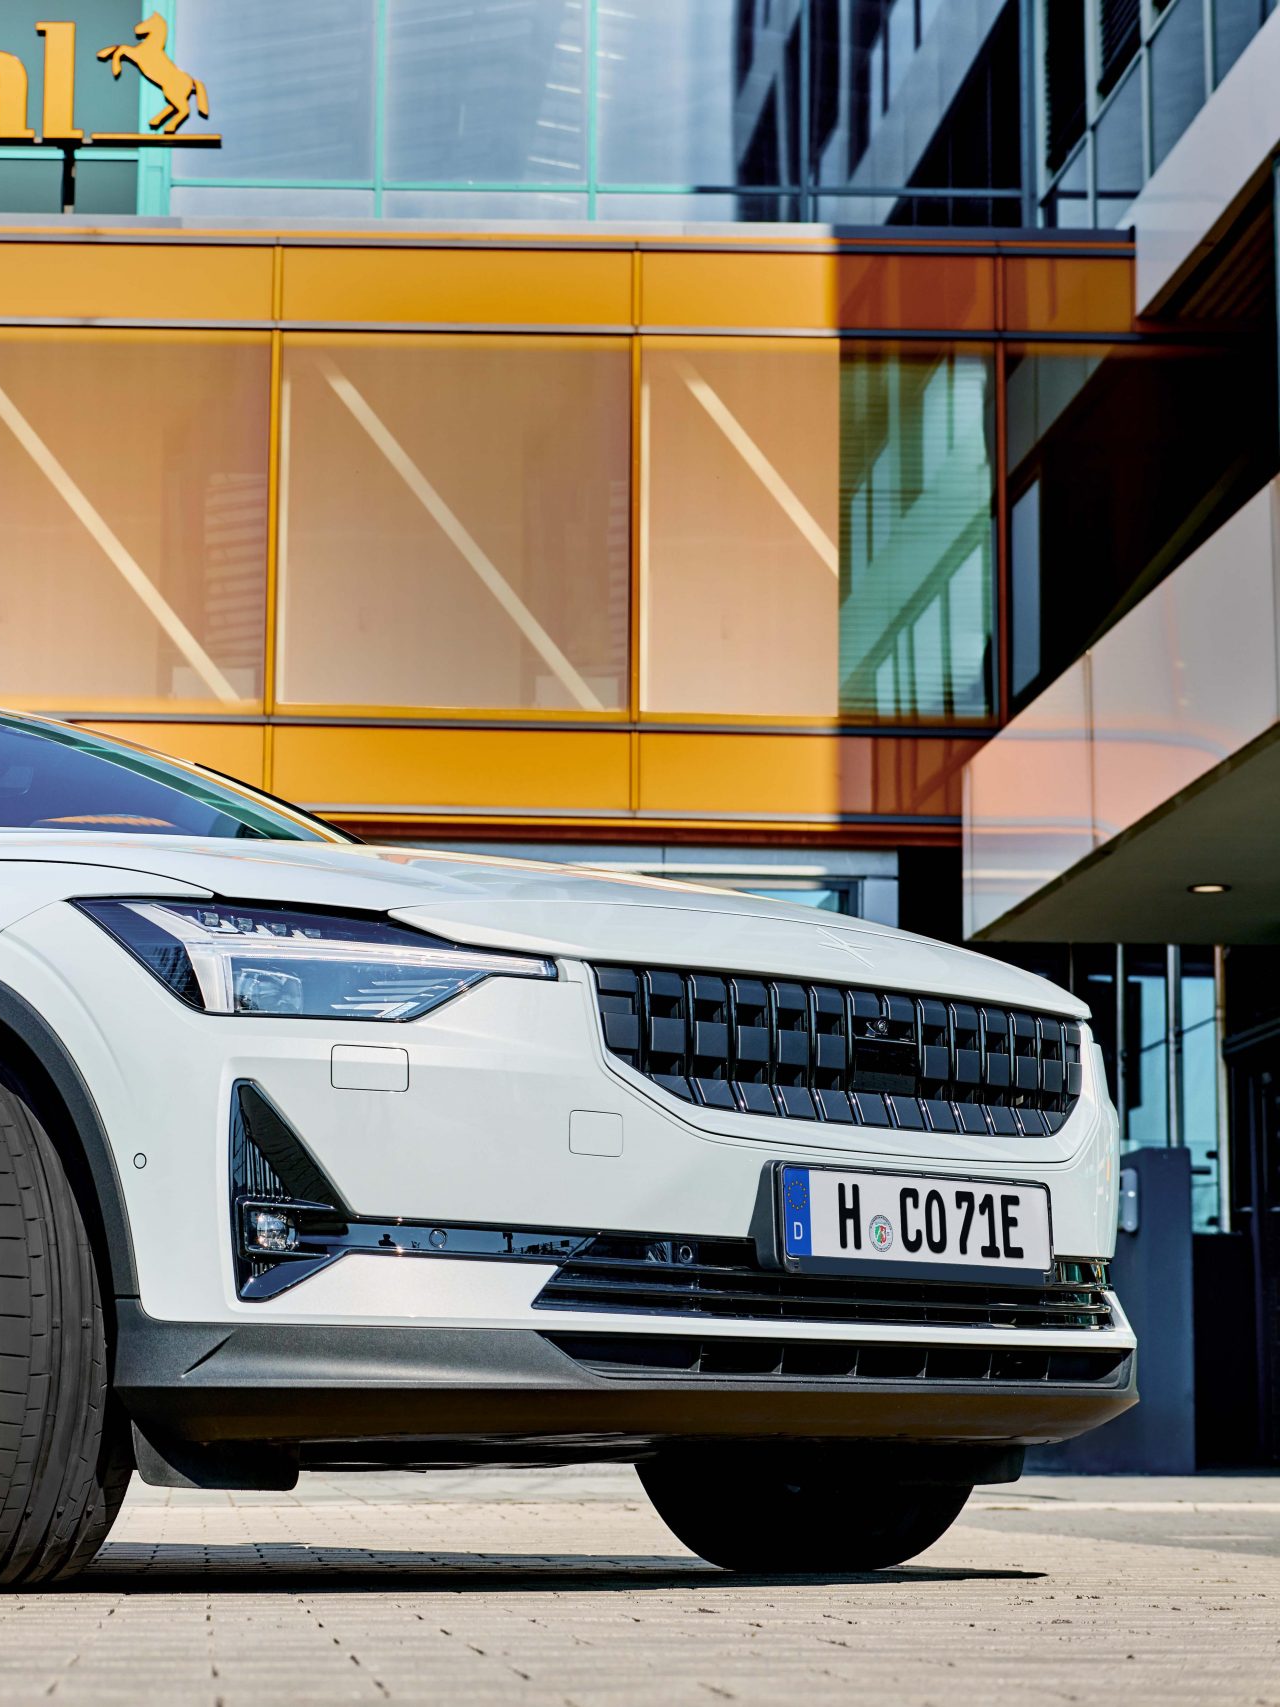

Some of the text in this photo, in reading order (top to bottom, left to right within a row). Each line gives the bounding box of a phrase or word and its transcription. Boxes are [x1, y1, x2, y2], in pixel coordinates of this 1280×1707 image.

[793, 1221, 803, 1240] D
[838, 1182, 862, 1249] H
[899, 1187, 948, 1253] CO
[955, 1190, 1024, 1259] 71E
